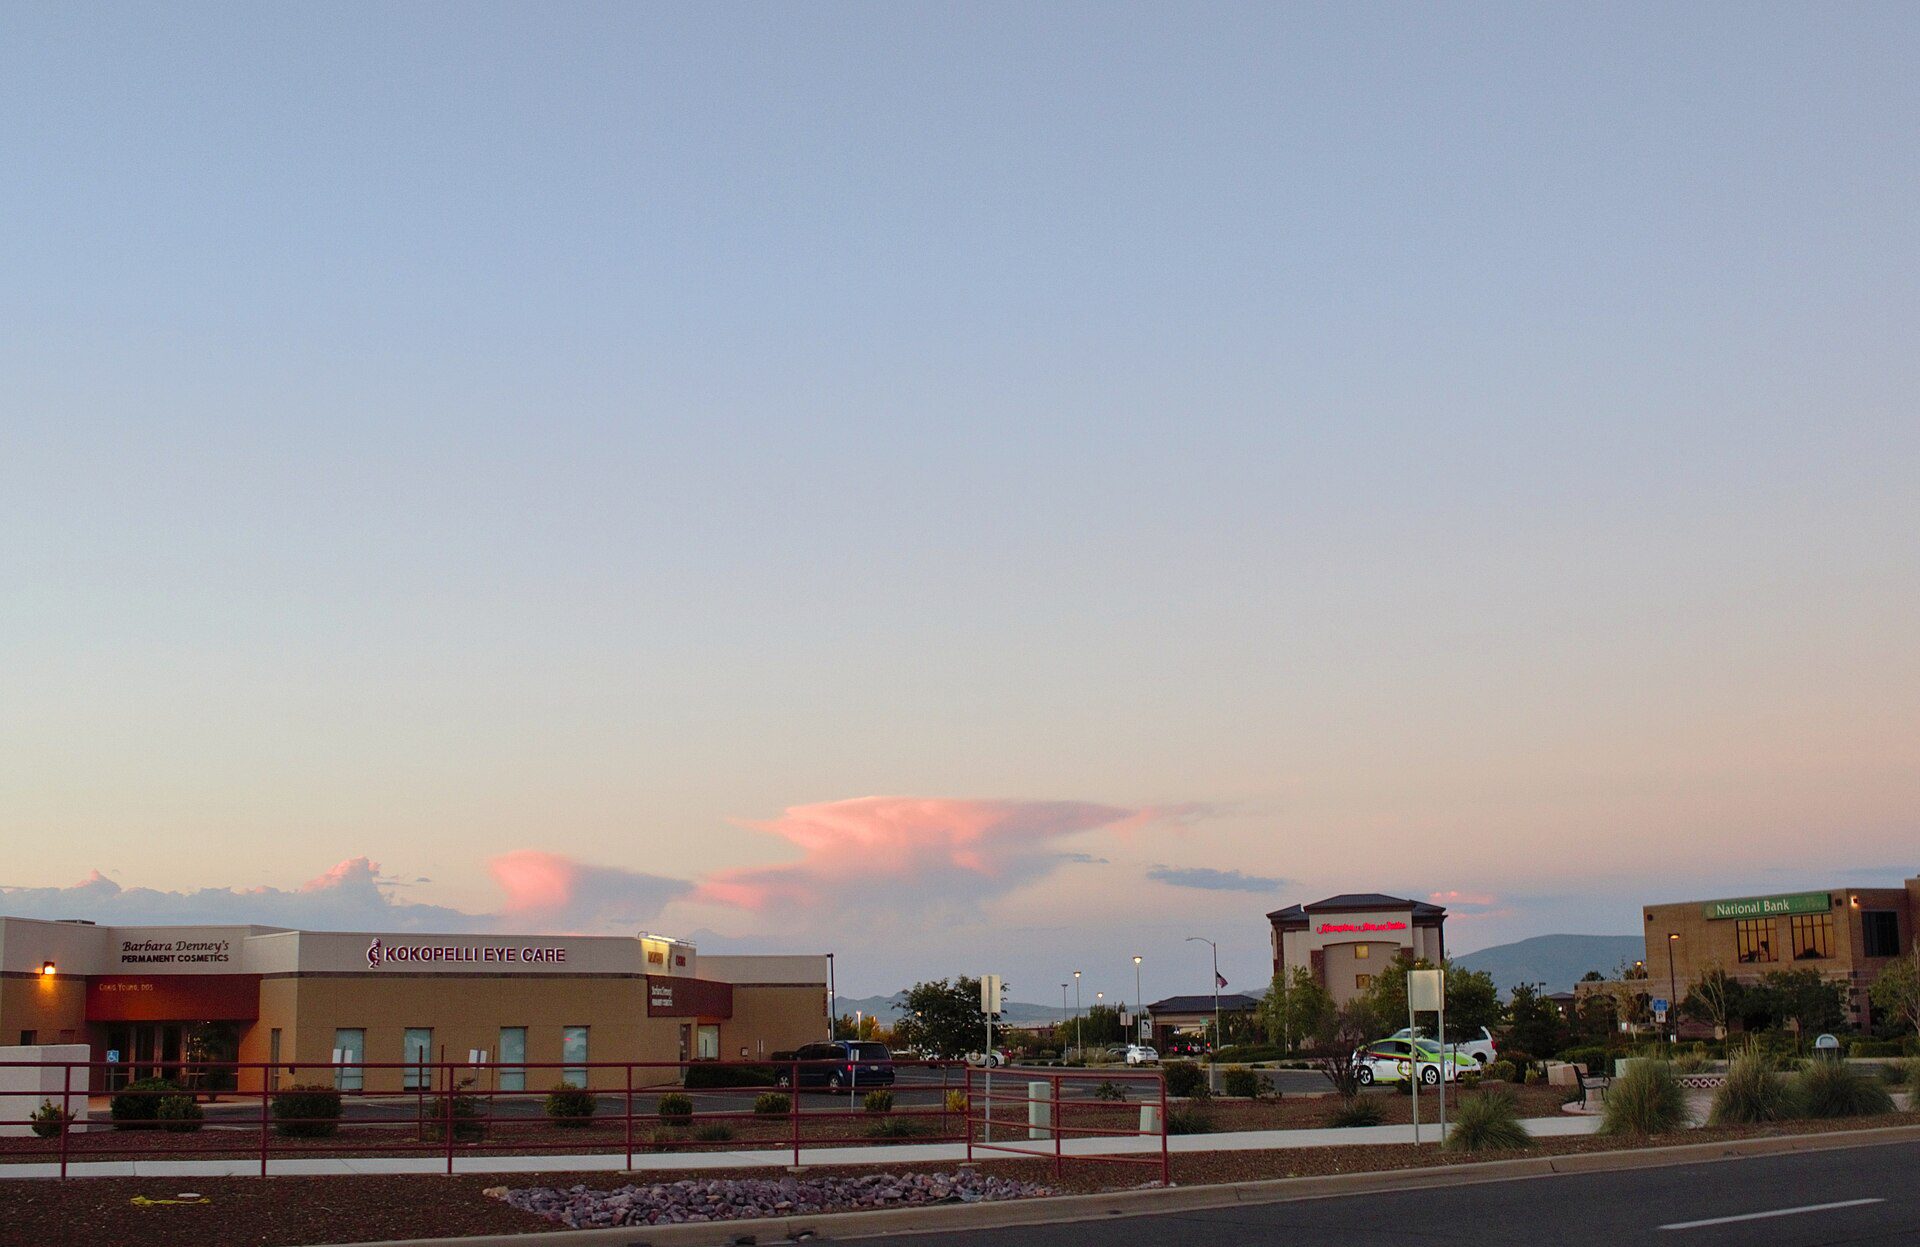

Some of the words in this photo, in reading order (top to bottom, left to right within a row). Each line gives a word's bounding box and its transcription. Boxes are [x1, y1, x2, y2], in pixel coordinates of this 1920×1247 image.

[1716, 901, 1760, 916] National
[1764, 899, 1790, 912] Bank
[122, 940, 172, 952] Barbara
[176, 940, 230, 954] Denney's
[384, 946, 478, 962] KOKOPELLI
[483, 947, 516, 962] EYE
[521, 947, 566, 963] CARE
[121, 954, 175, 963] PERMANENT
[177, 954, 229, 963] COSMETICS
